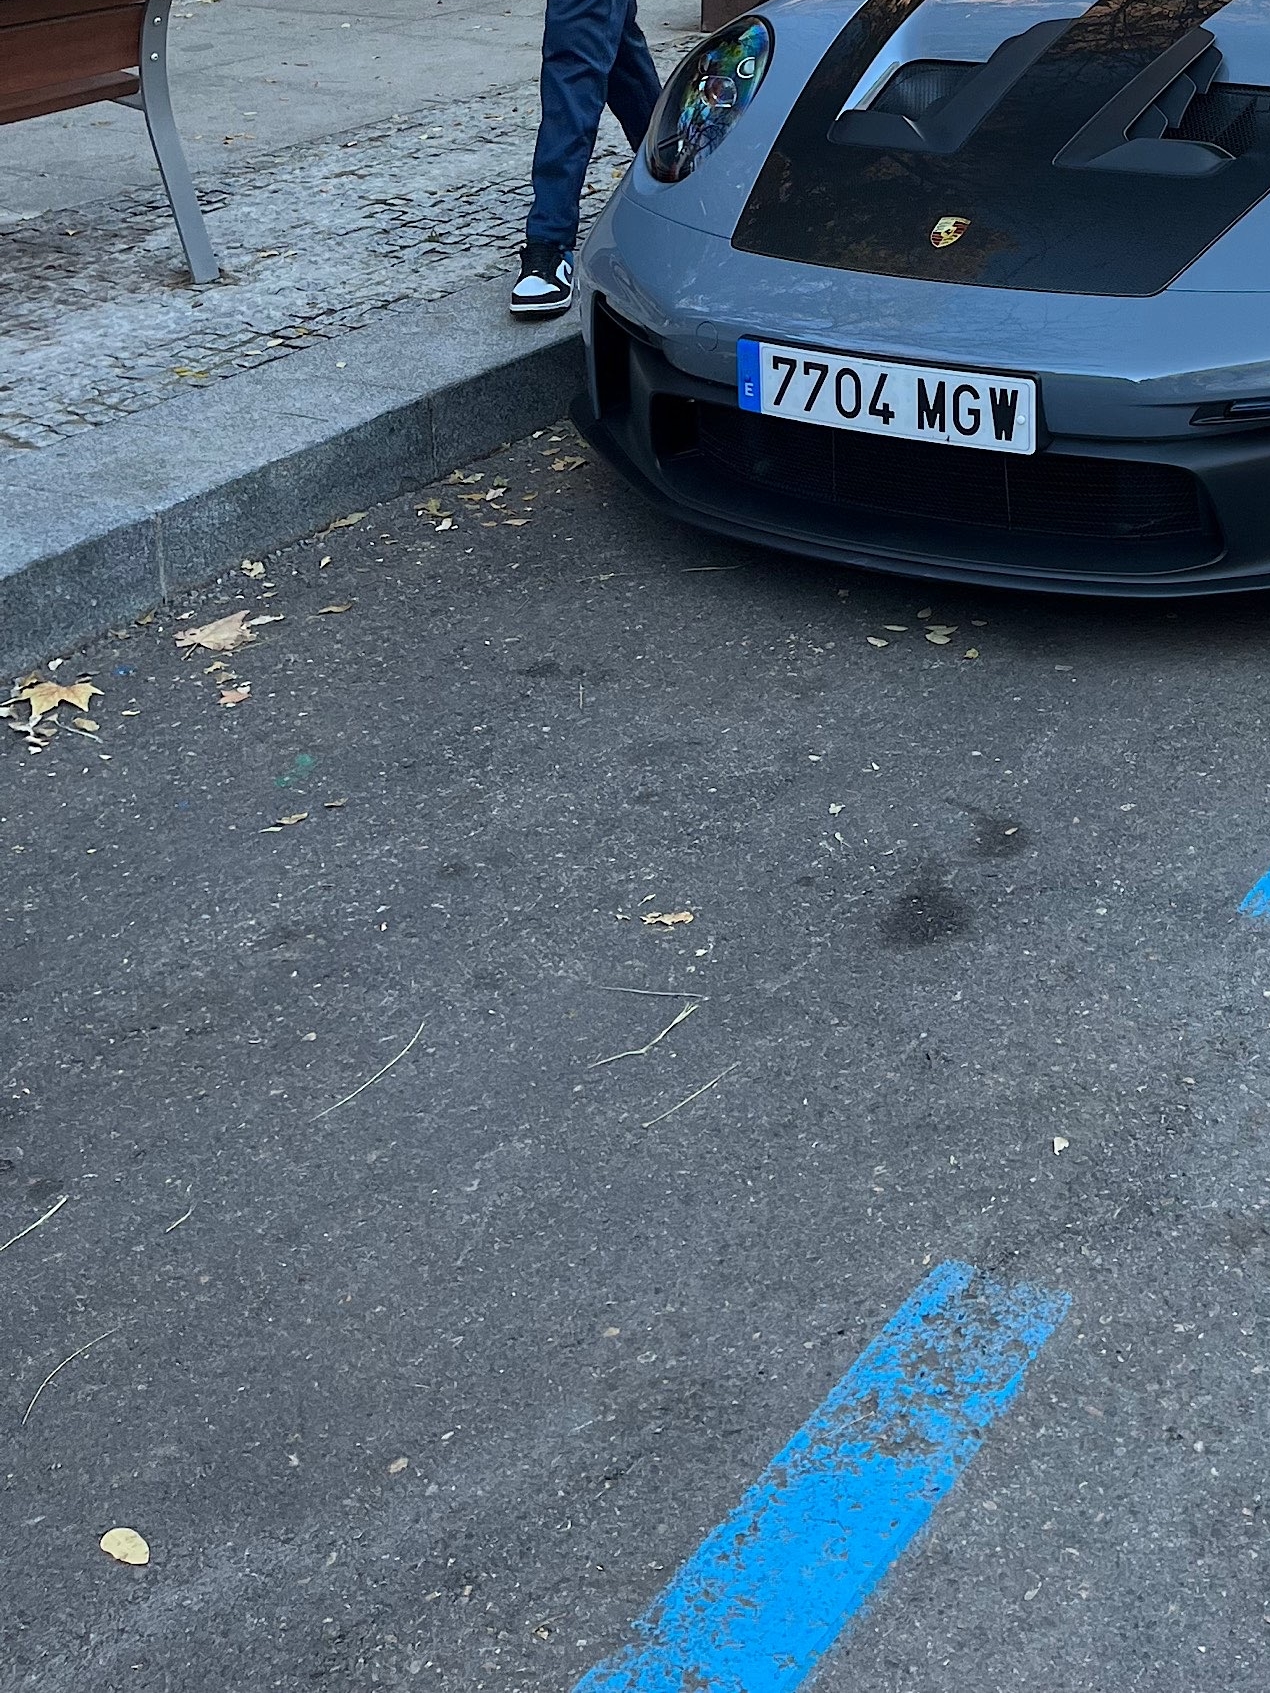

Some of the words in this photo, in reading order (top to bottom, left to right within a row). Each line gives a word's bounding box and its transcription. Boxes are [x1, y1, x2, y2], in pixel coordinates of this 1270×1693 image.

[743, 381, 755, 397] E
[771, 355, 896, 426] 7704
[916, 376, 1019, 442] MGW
